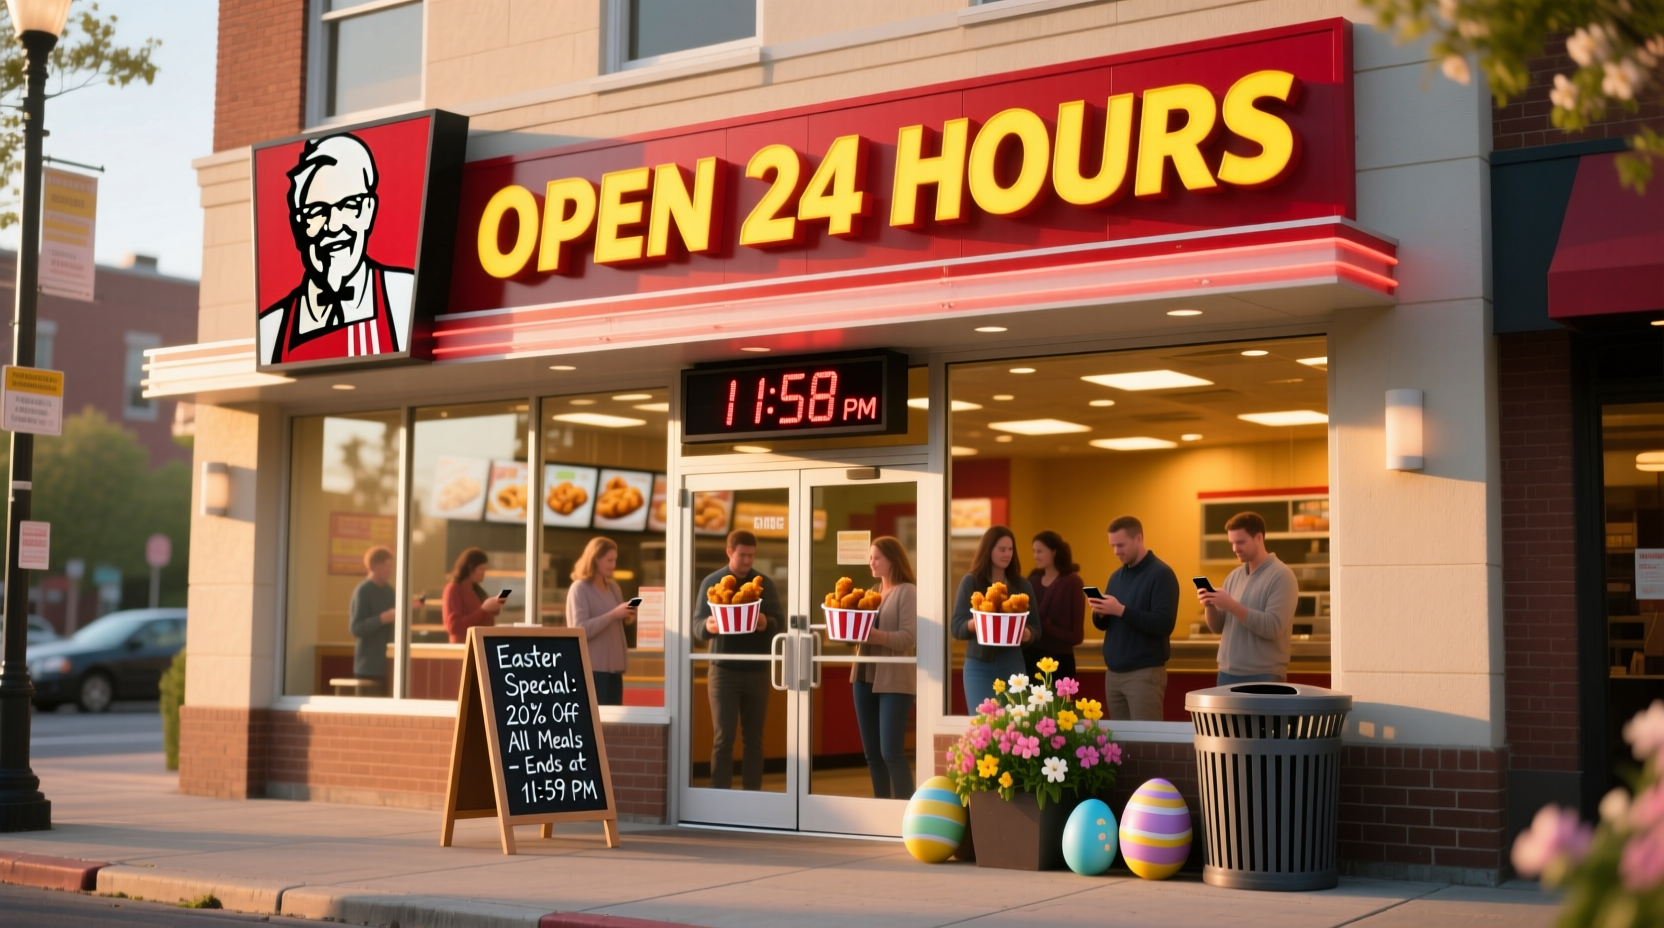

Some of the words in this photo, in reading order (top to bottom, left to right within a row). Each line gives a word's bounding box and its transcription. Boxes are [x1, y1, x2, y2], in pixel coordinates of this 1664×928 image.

[478, 156, 719, 279] OPEN
[739, 134, 863, 246] 24
[889, 69, 1295, 227] HOURS
[726, 371, 838, 426] 11:58
[843, 397, 877, 420] PM
[496, 644, 562, 668] Easter
[504, 671, 577, 703] Special:
[506, 703, 546, 725] 20%
[552, 702, 579, 723] Off
[508, 730, 530, 753] All
[538, 728, 583, 749] Meals
[525, 754, 563, 774] Ends
[569, 752, 587, 771] at
[521, 778, 565, 803] 11:59
[571, 780, 598, 801] PM
